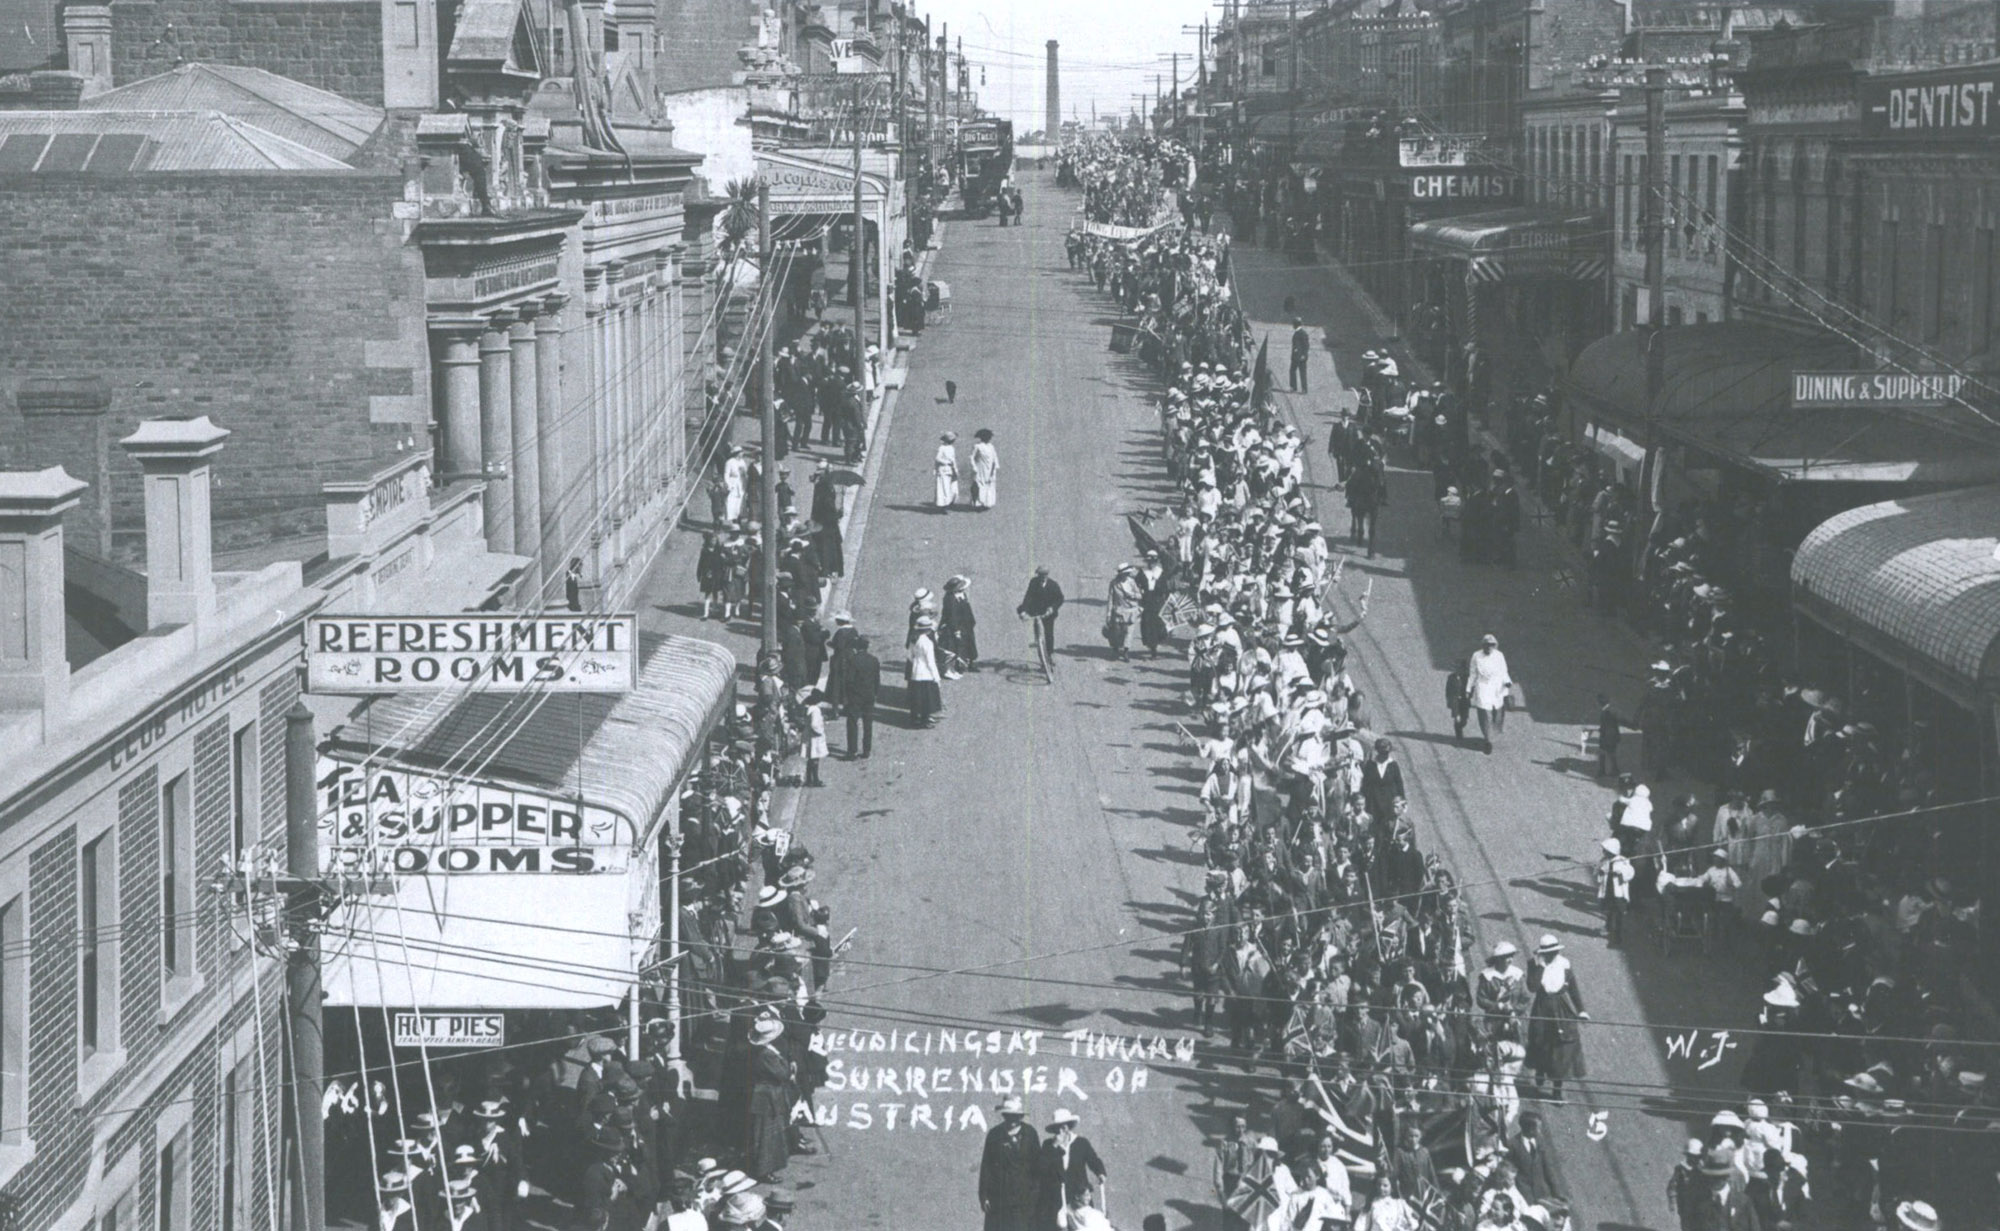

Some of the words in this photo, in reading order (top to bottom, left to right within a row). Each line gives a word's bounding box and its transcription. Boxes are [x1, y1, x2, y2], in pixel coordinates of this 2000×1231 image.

[1413, 175, 1518, 197] CHEMIST
[1795, 374, 1856, 400] DINING
[1859, 381, 1871, 400] &
[1873, 374, 1943, 400] SUPPER
[368, 472, 405, 522] EMPIRE
[318, 622, 624, 653] REFRESHMENT
[374, 656, 577, 683] ROOMS.
[110, 714, 167, 772] CLUB
[181, 662, 246, 724] HOTEL
[317, 766, 401, 808] TEA
[341, 812, 366, 839] &
[377, 802, 583, 840] SUPPER
[397, 1015, 440, 1036] HOT
[449, 1015, 500, 1036] PIES
